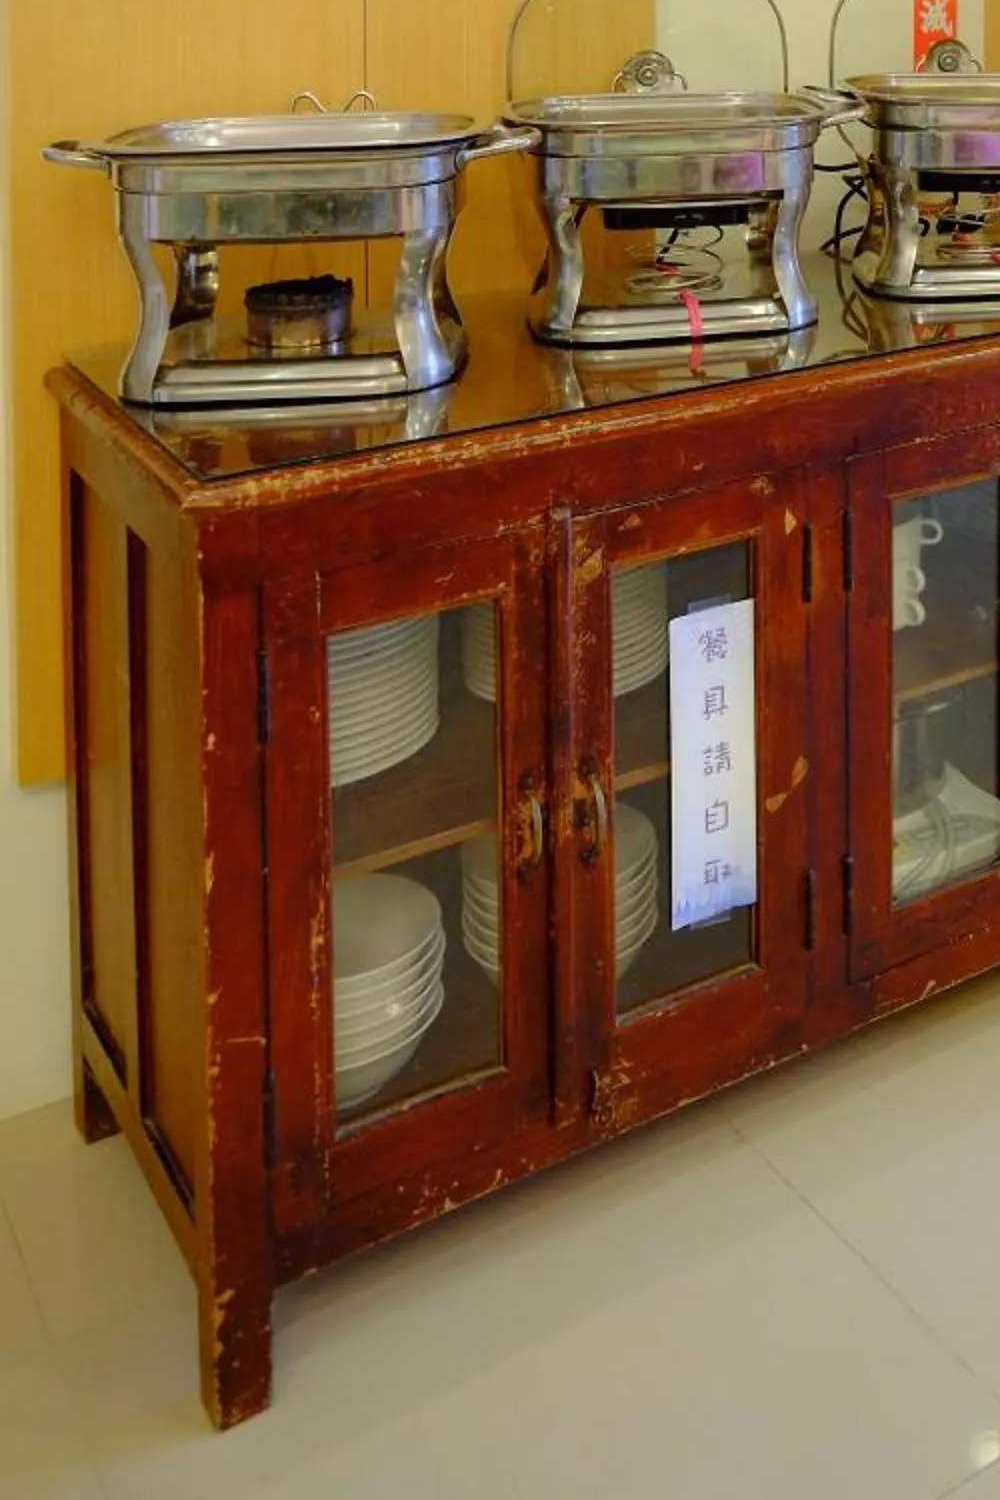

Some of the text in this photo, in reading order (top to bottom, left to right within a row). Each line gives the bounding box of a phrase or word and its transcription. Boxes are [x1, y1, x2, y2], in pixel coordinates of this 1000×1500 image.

[699, 627, 732, 886] 餐具請自取
